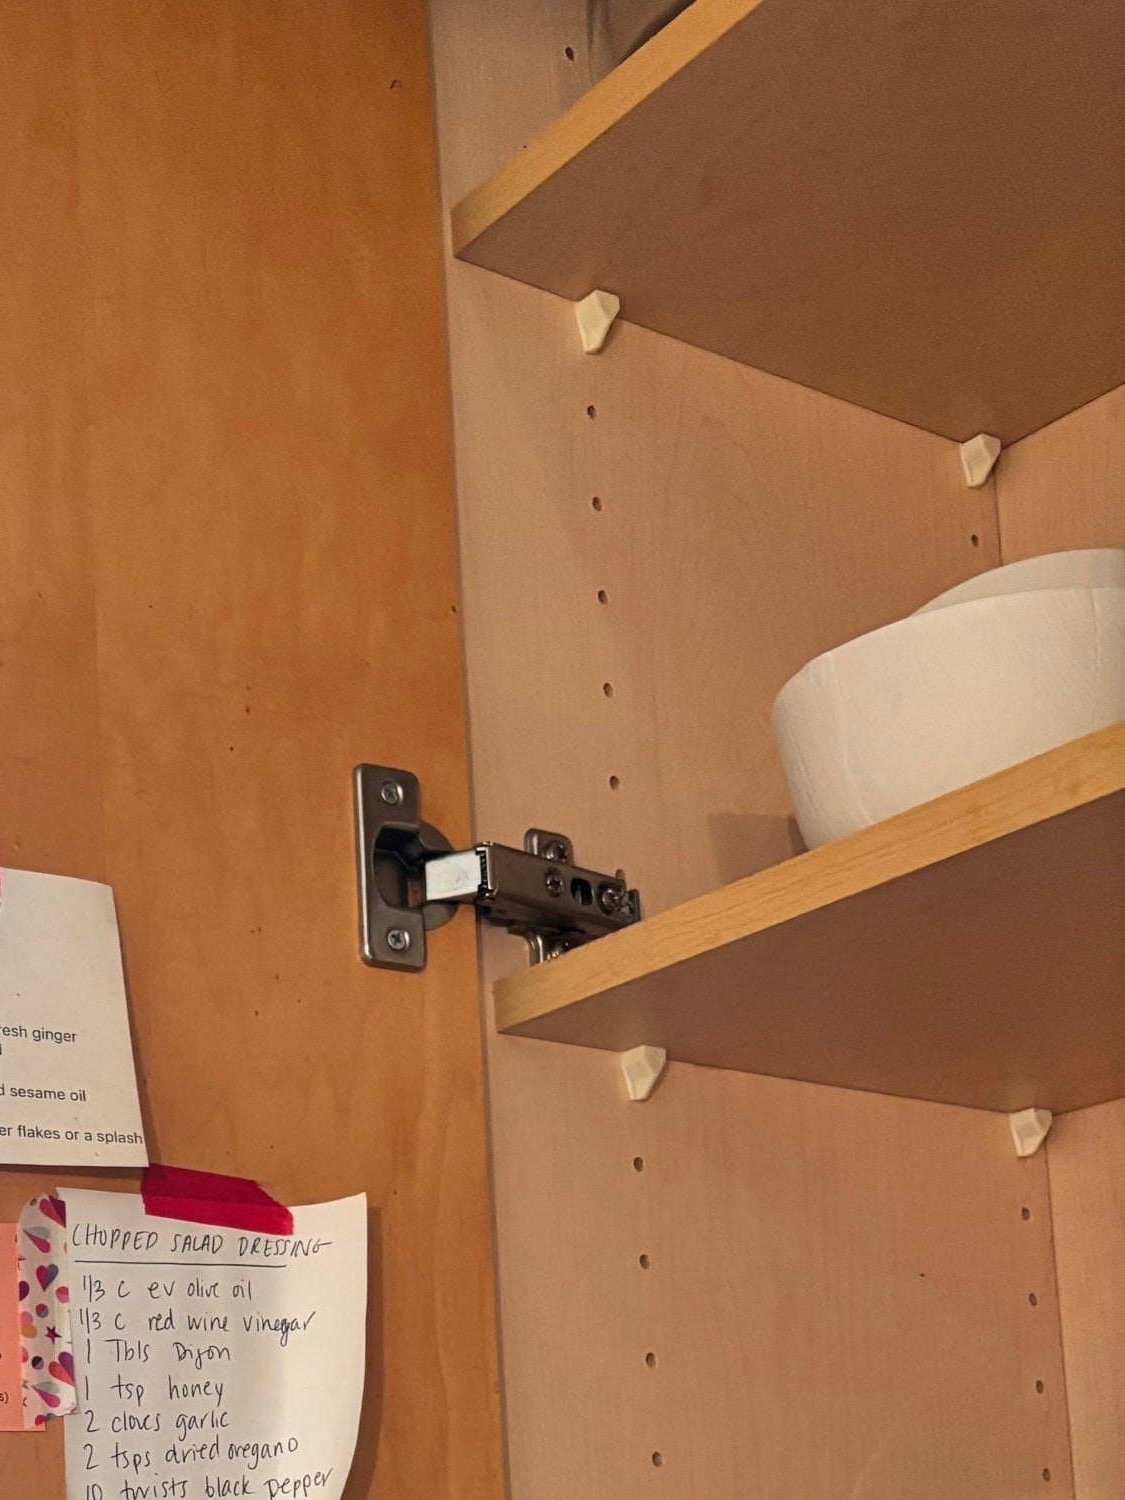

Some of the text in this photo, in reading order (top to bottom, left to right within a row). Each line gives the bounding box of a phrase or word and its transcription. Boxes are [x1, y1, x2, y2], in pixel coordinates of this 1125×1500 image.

[71, 1223, 333, 1258] CHOPPED SALAD DRESSING
[82, 1274, 106, 1302] 1/3
[187, 1279, 221, 1300] olive
[232, 1278, 252, 1301] oil
[110, 1373, 145, 1403] tsp
[168, 1367, 224, 1406] honey
